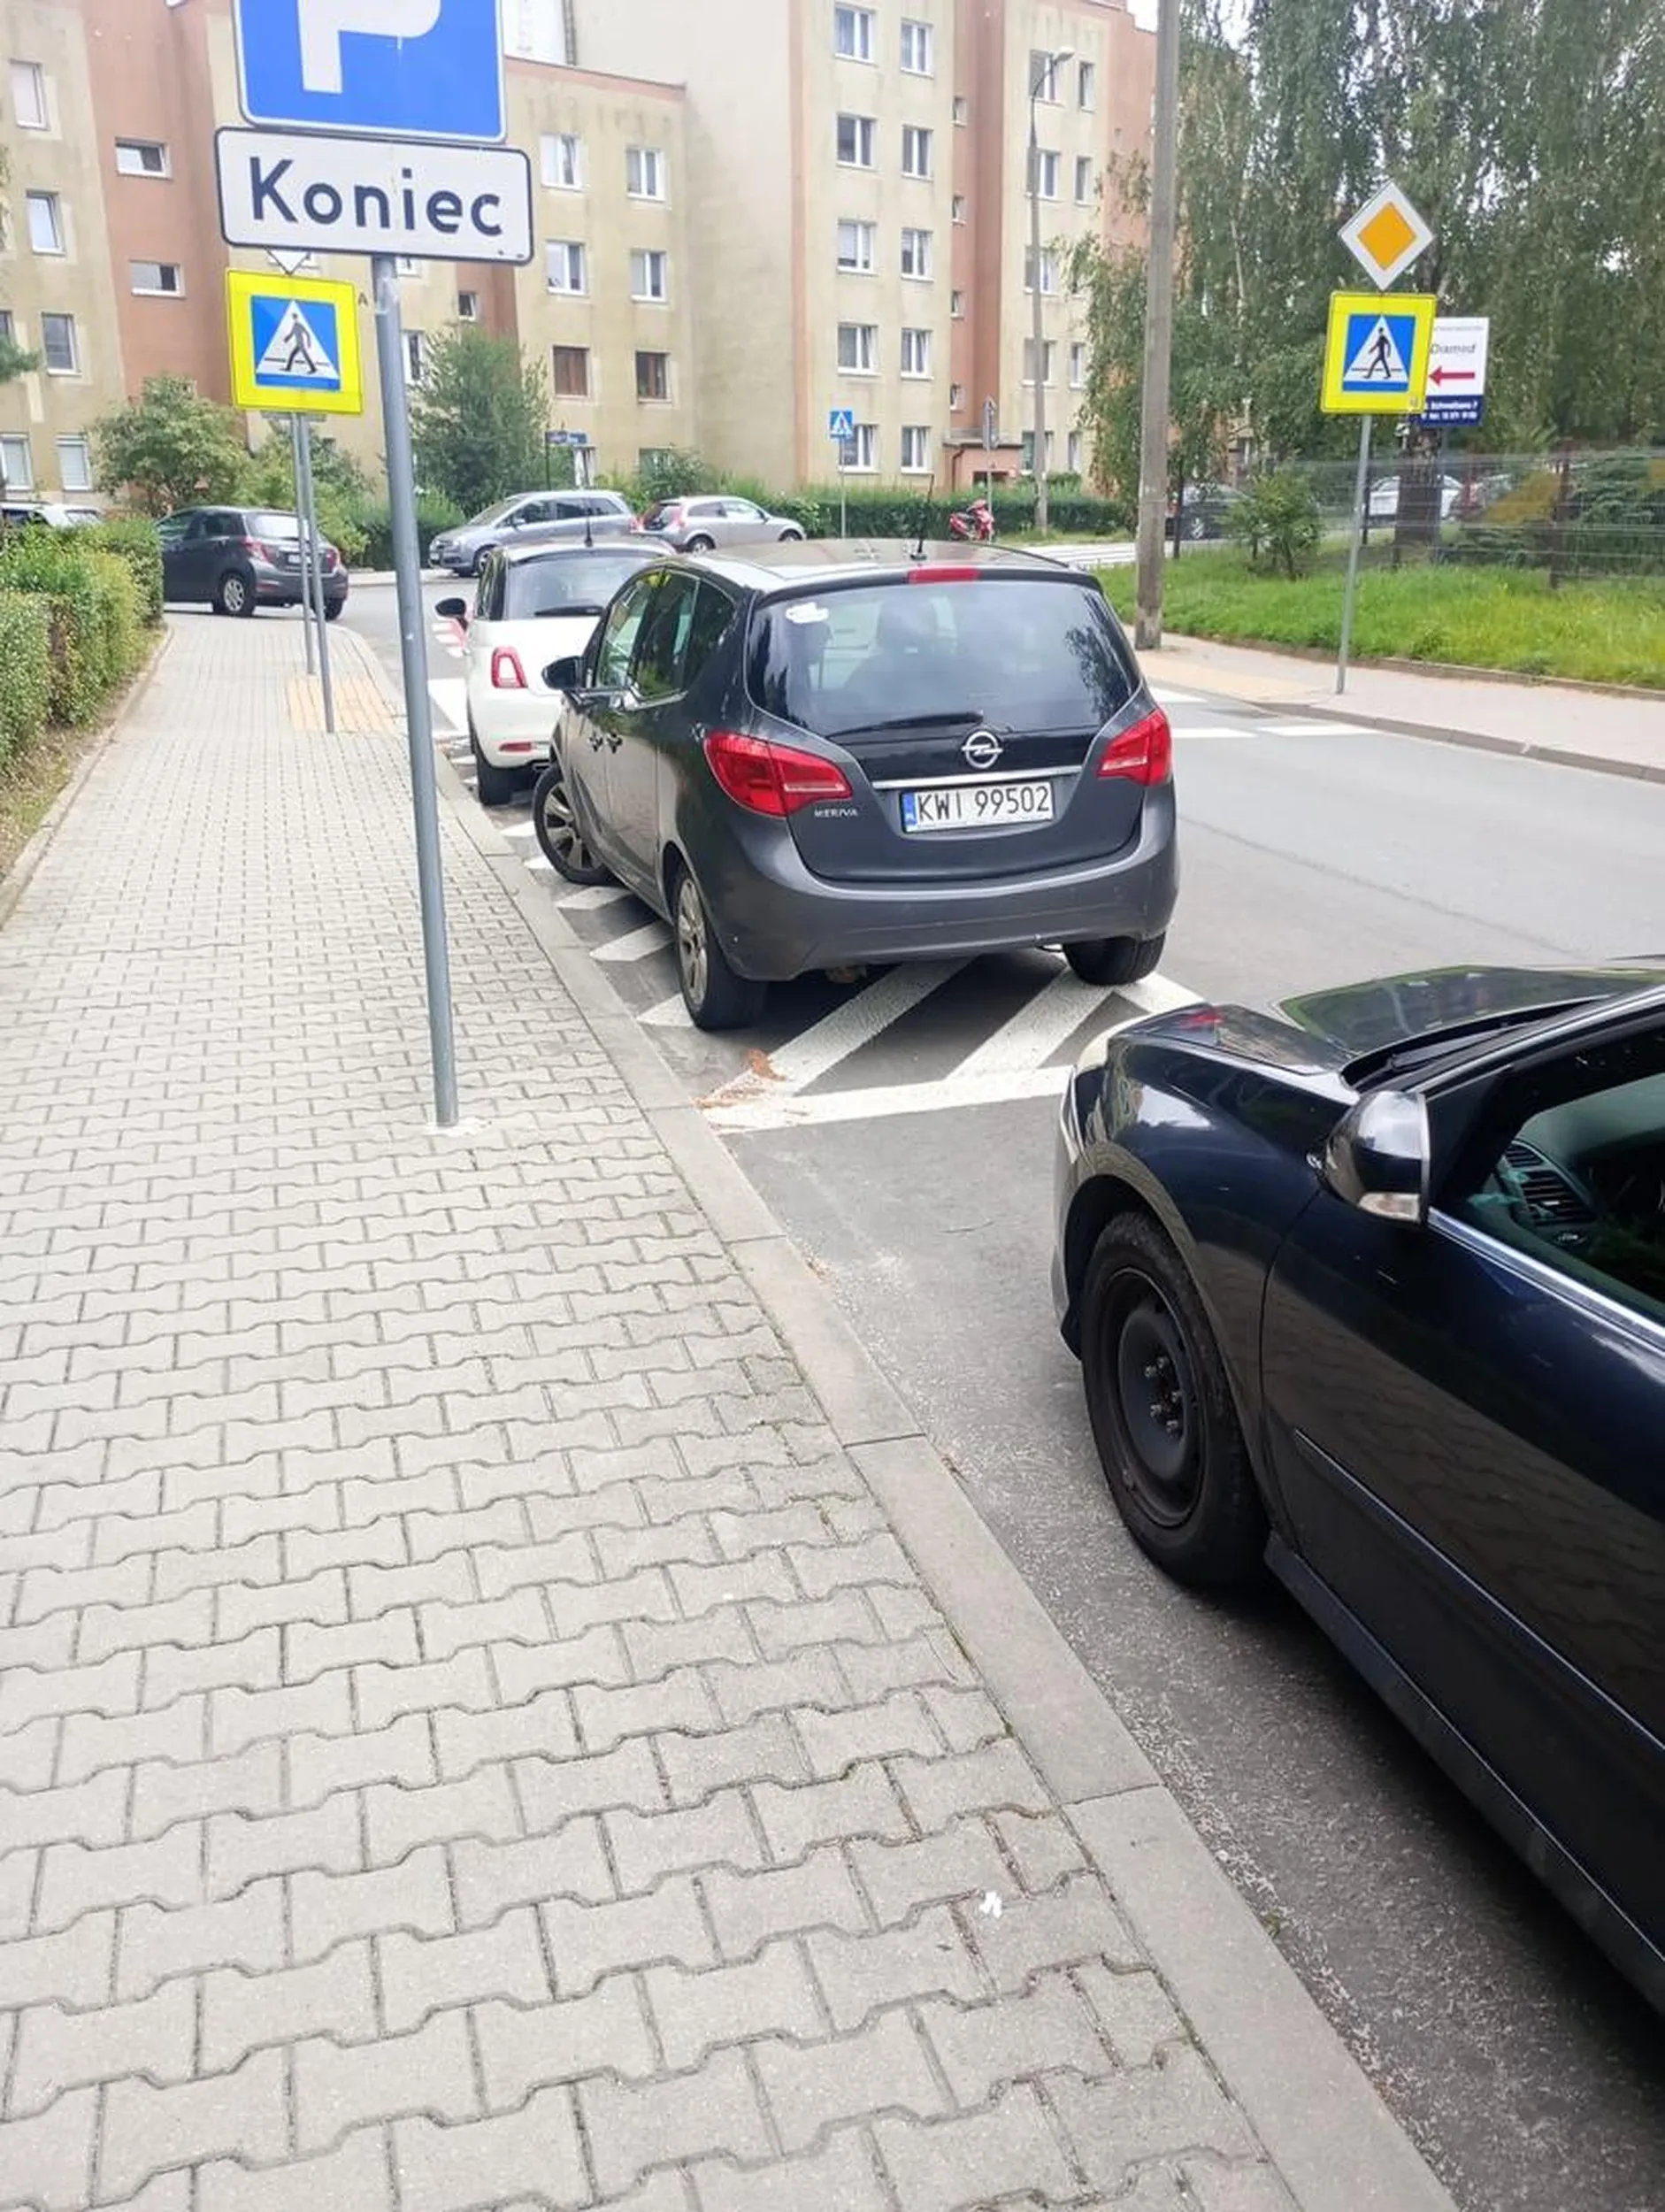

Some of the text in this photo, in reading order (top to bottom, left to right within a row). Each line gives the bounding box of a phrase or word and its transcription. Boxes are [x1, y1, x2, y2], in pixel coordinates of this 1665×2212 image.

[249, 156, 503, 237] Koniec
[918, 785, 1050, 821] KWI 99502
